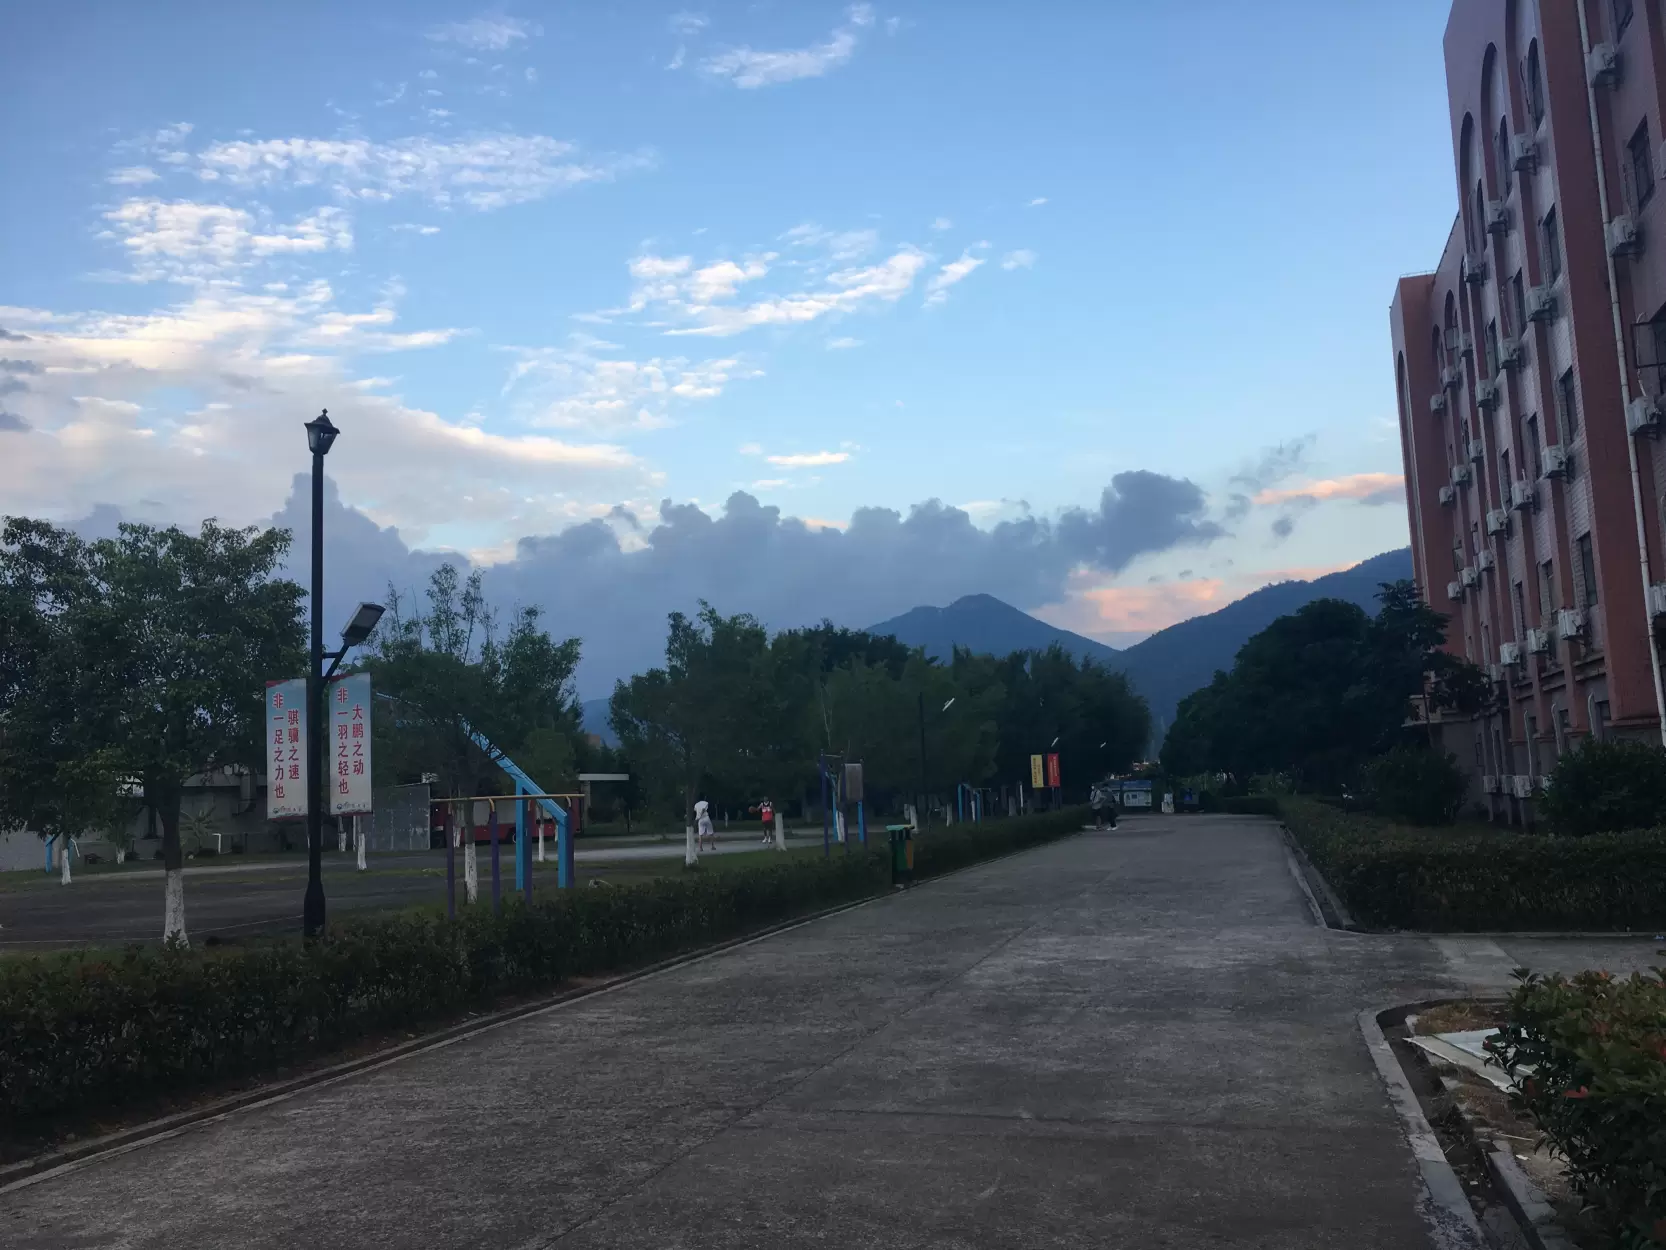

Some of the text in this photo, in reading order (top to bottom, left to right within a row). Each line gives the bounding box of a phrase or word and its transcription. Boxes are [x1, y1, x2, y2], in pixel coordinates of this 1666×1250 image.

[273, 693, 285, 798] 非一足之力也
[337, 688, 349, 794] 非一羽之轻也
[352, 704, 364, 775] 大鹏之动
